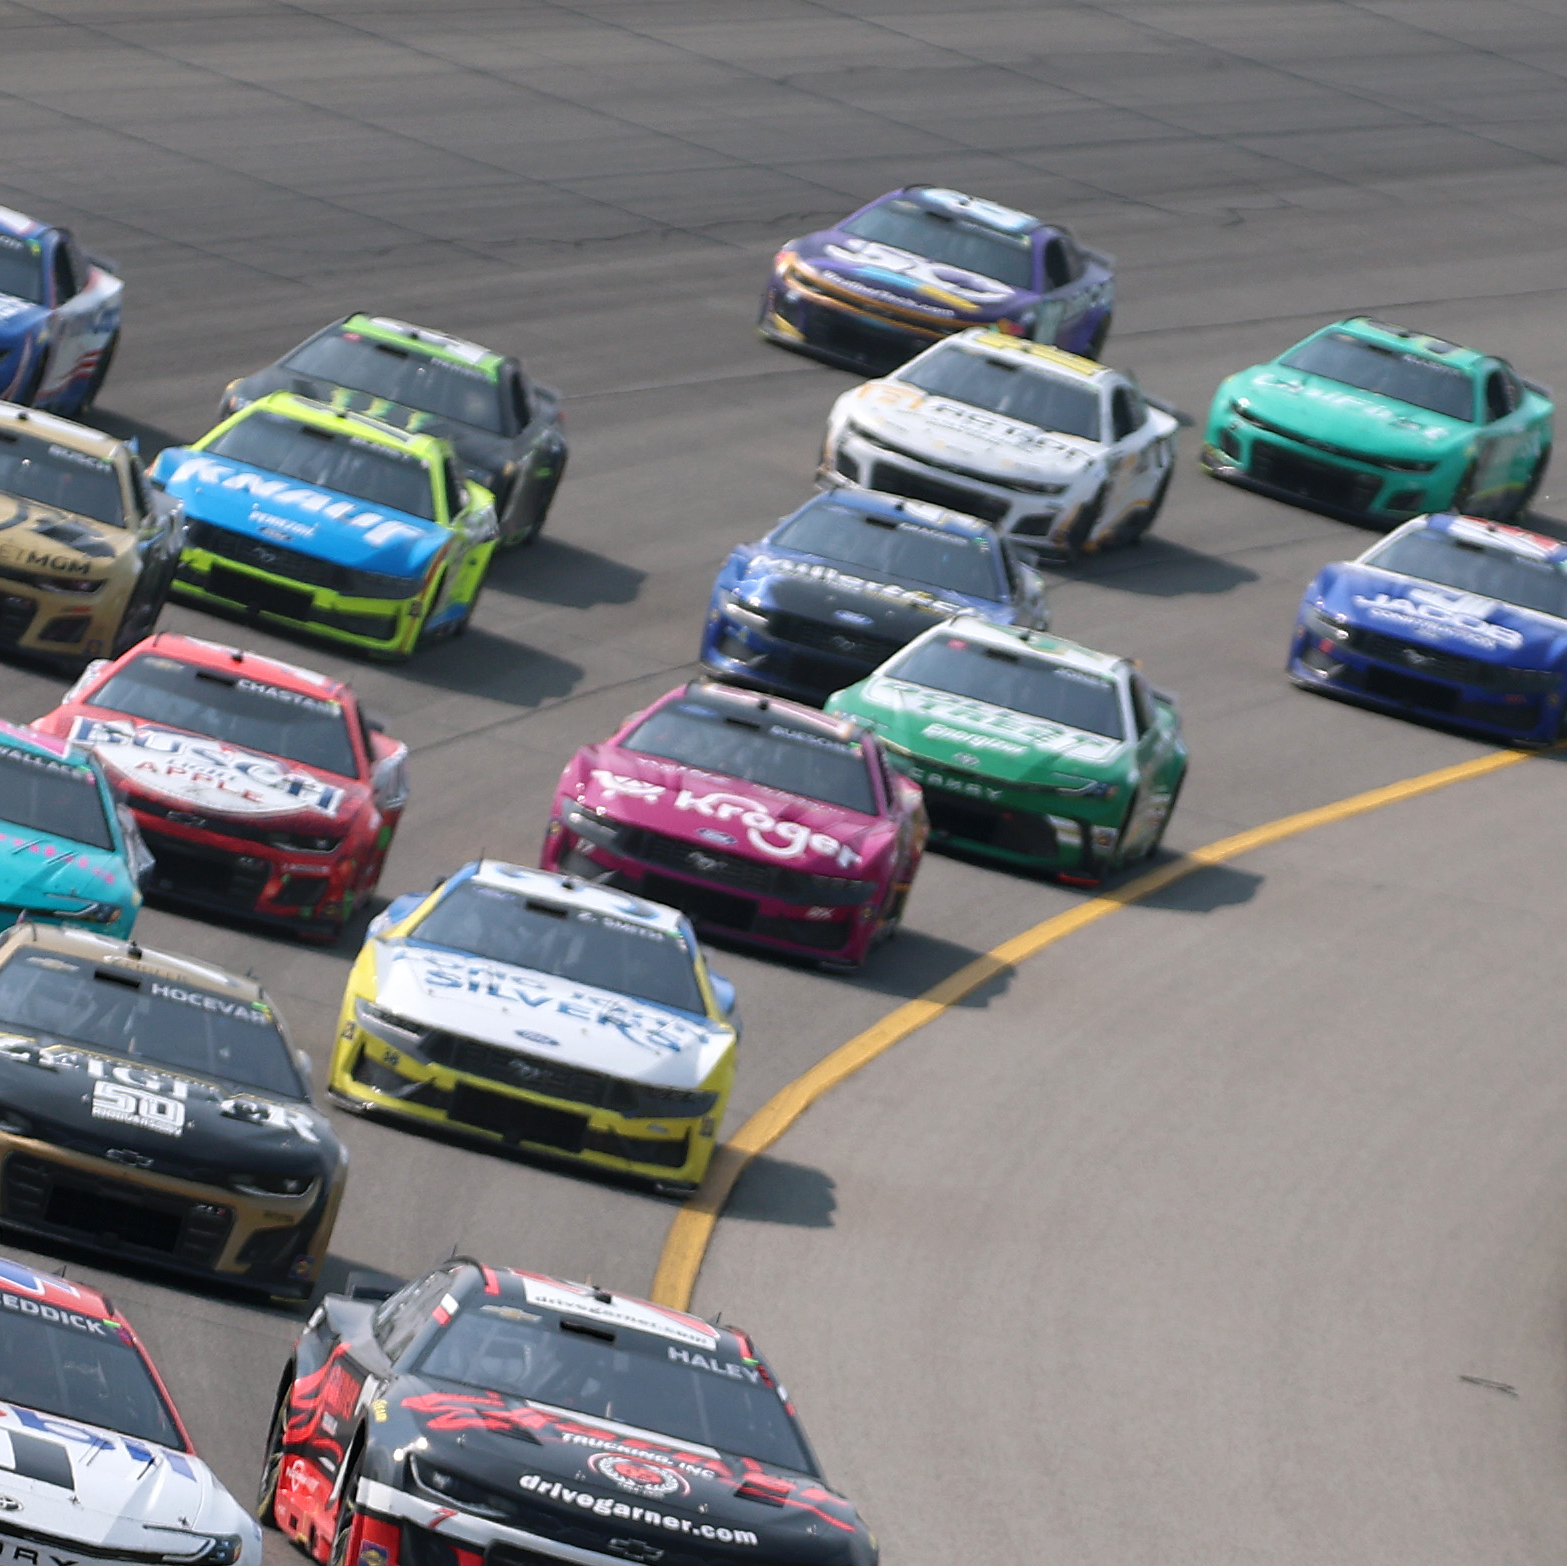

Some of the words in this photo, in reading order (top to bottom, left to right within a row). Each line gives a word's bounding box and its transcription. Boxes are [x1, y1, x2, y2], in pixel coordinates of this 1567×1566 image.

[170, 458, 426, 548] KNAUF
[674, 790, 864, 869] Kroger
[150, 982, 268, 1025] HOCEVAR
[667, 1345, 761, 1386] HALEY
[519, 1473, 759, 1547] drivegarner.com
